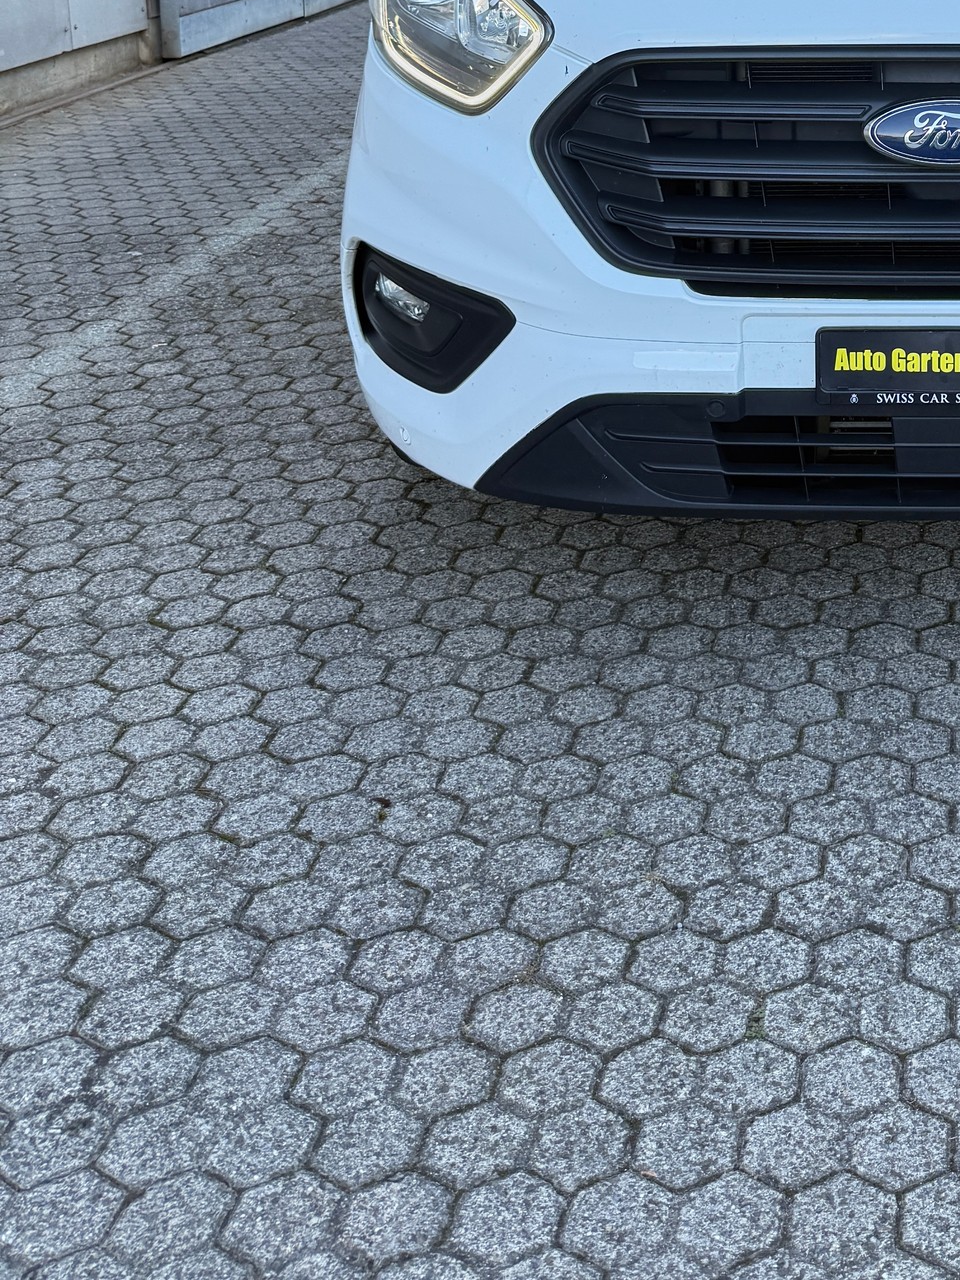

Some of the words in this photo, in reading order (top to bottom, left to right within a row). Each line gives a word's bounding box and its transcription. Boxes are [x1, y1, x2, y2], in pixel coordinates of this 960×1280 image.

[834, 347, 886, 372] Auto
[876, 393, 915, 404] SWISS
[919, 393, 950, 404] CAR
